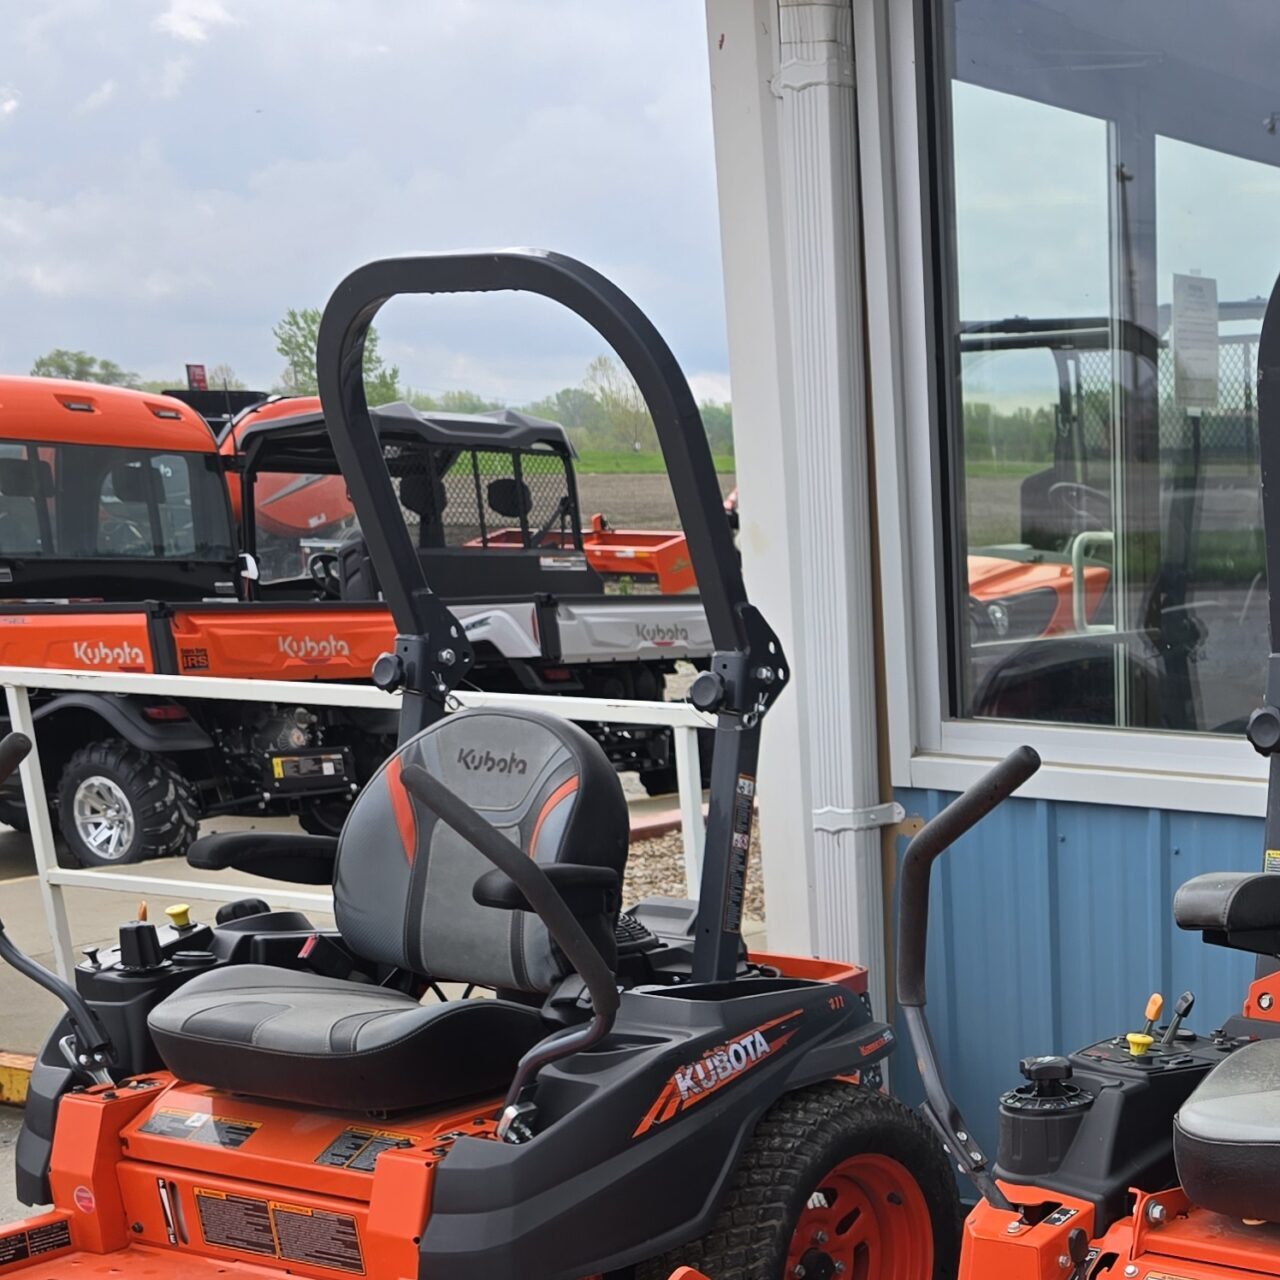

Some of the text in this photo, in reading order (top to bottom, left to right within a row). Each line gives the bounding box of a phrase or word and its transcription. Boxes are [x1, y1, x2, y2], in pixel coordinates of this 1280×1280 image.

[636, 624, 689, 641] Kubota
[73, 641, 145, 665] Kubota
[278, 635, 350, 659] Kubota
[183, 655, 208, 668] IRS
[456, 748, 528, 775] Kubota
[673, 1030, 772, 1100] KUBOTA
